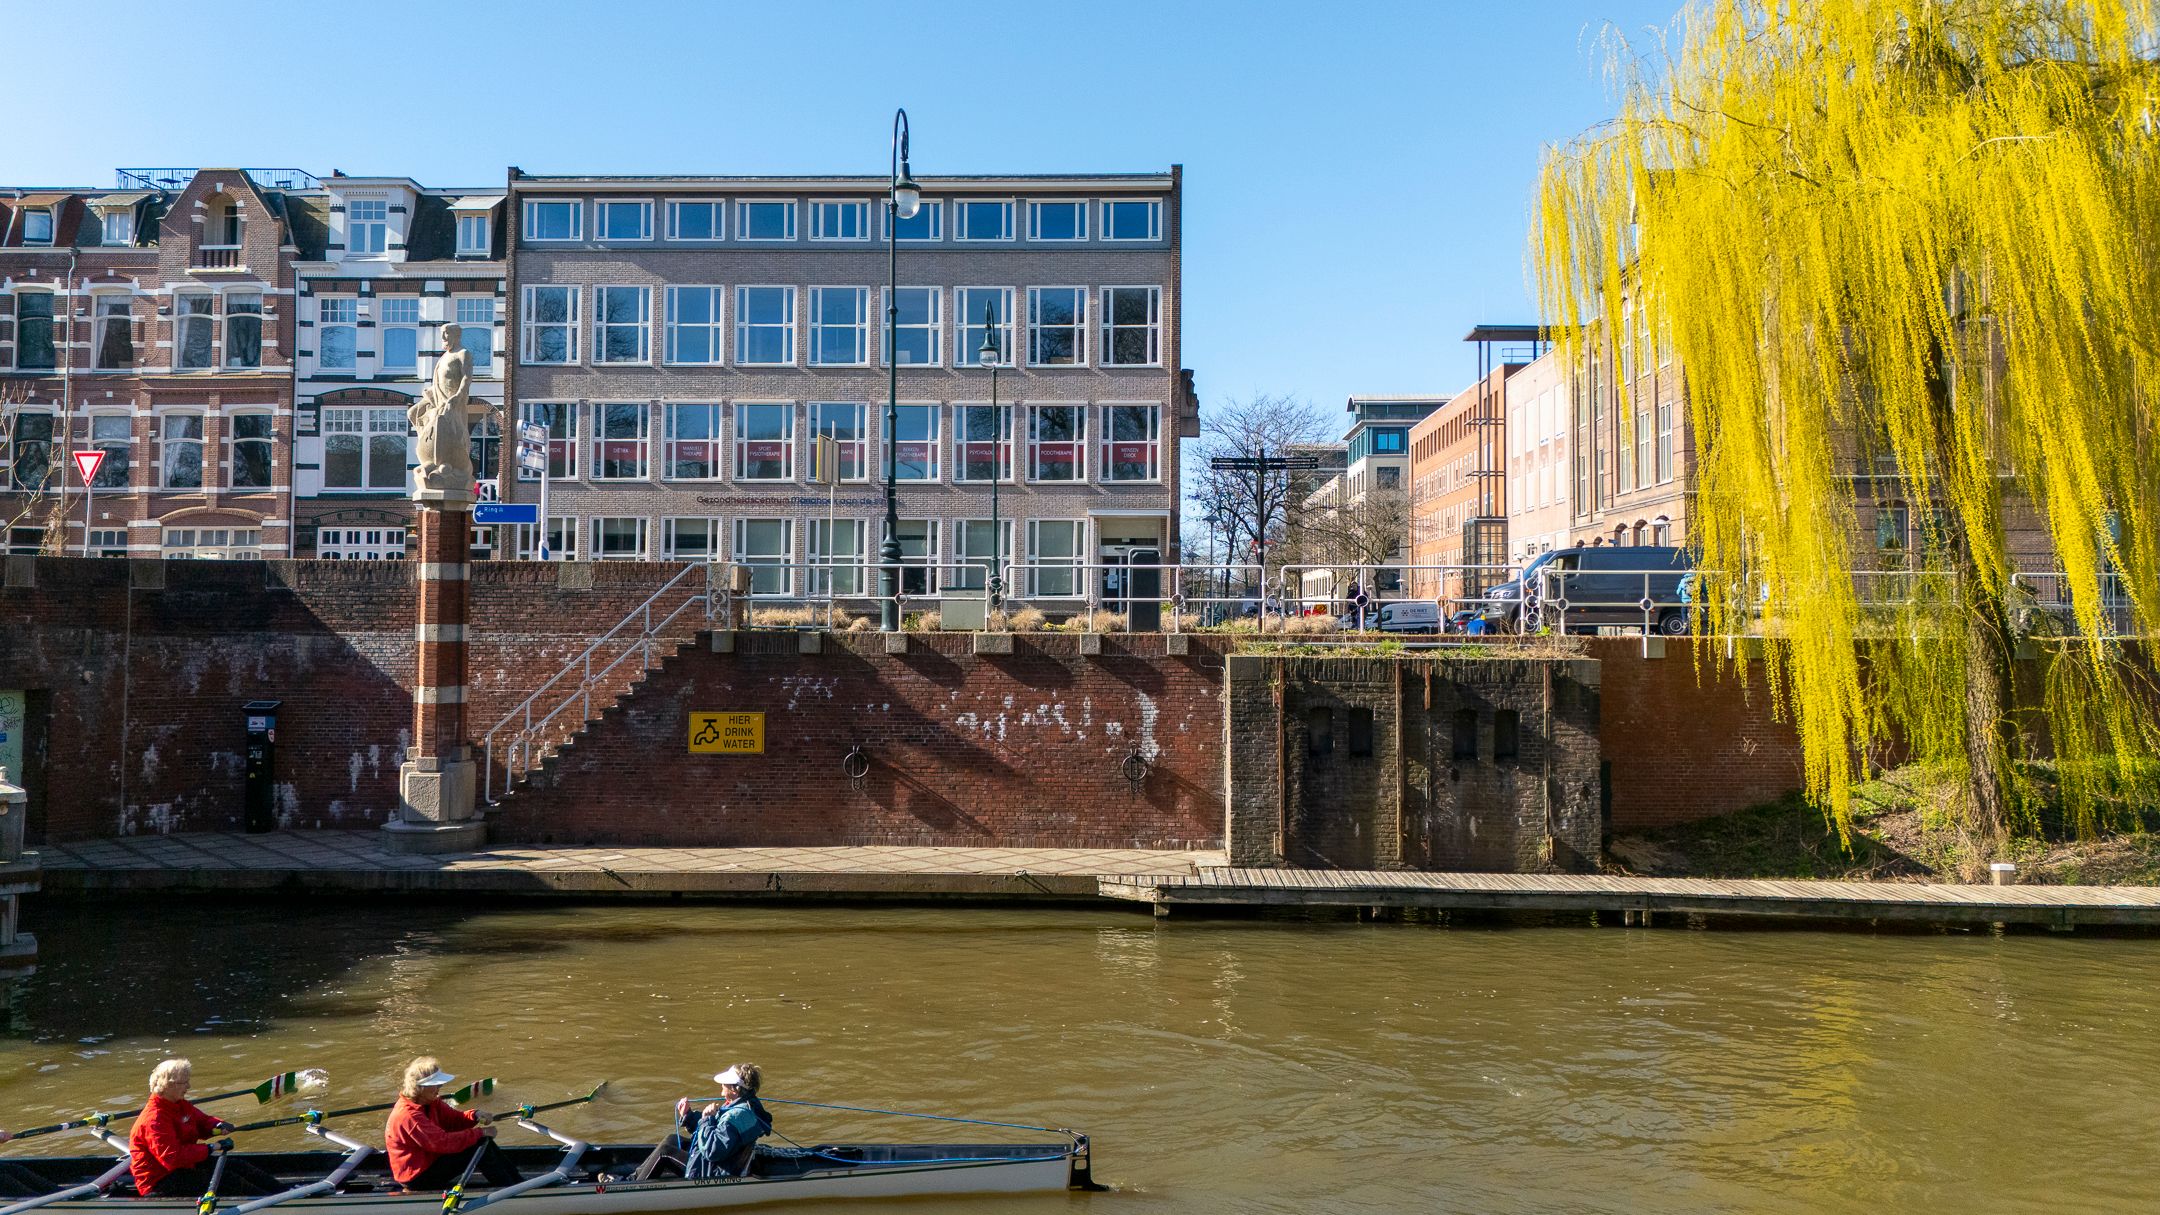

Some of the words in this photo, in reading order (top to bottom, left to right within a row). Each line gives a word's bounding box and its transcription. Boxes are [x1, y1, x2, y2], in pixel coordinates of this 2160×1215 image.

[697, 496, 790, 505] Gezondheidscentrum
[729, 715, 751, 725] HIER
[725, 727, 754, 737] DRINK
[723, 739, 755, 749] WATER
[714, 1176, 743, 1184] VIKING
